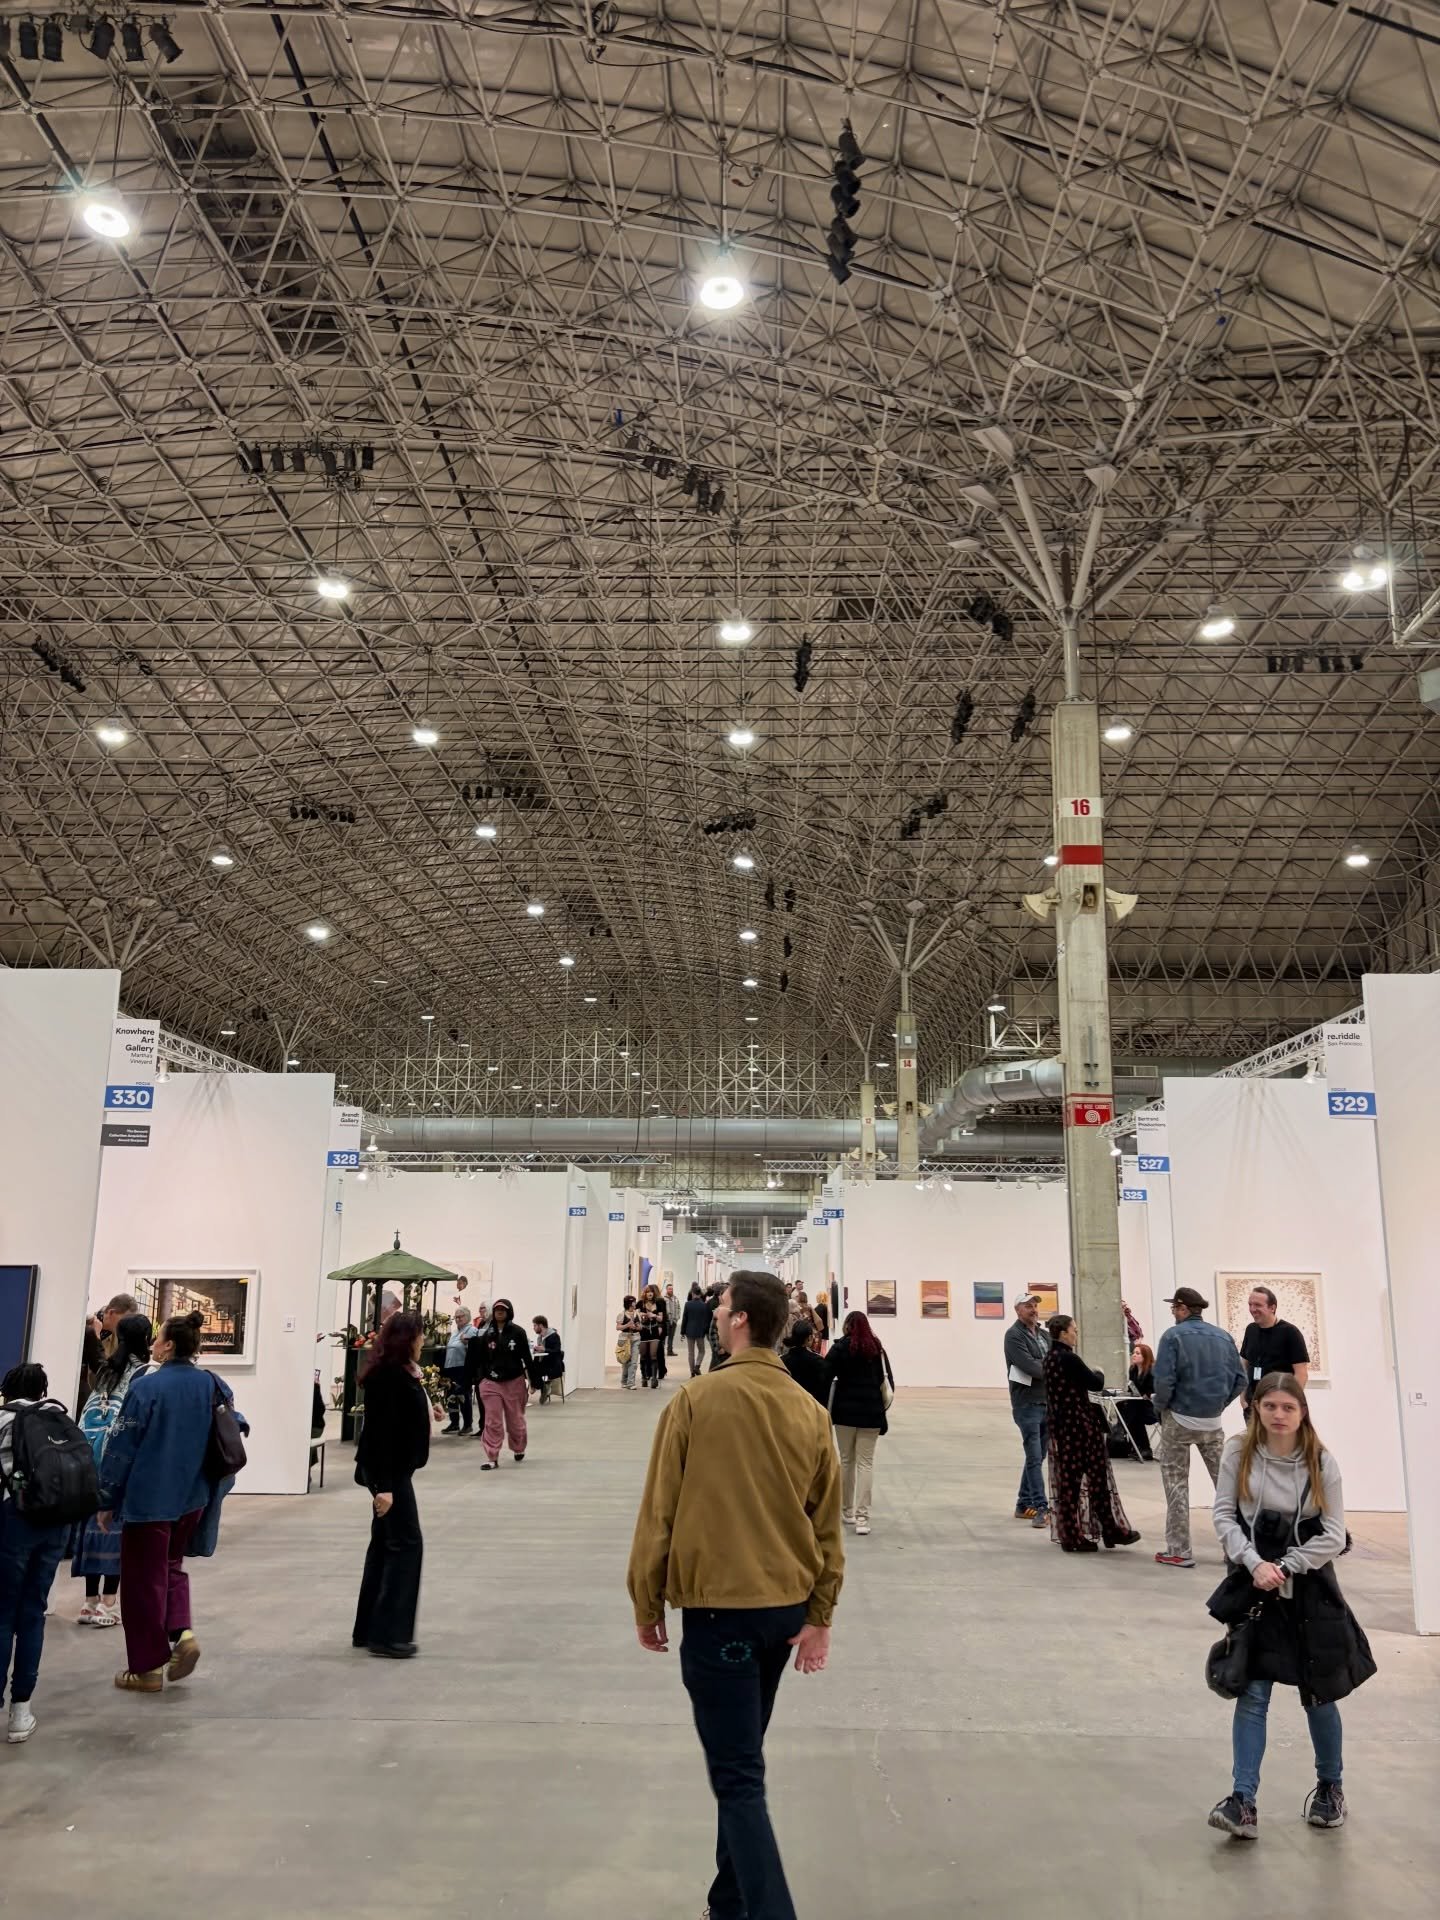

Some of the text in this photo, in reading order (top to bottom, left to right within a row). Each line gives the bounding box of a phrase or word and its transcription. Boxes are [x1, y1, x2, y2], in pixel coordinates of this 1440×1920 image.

[1071, 799, 1090, 816] 16
[115, 1027, 155, 1036] Knowhere
[140, 1036, 154, 1044] Art
[125, 1044, 154, 1054] Gallery
[112, 1089, 150, 1105] 330
[1331, 1096, 1368, 1112] 329
[333, 1154, 357, 1165] 328
[1140, 1159, 1164, 1170] 327
[1124, 1191, 1144, 1200] 325
